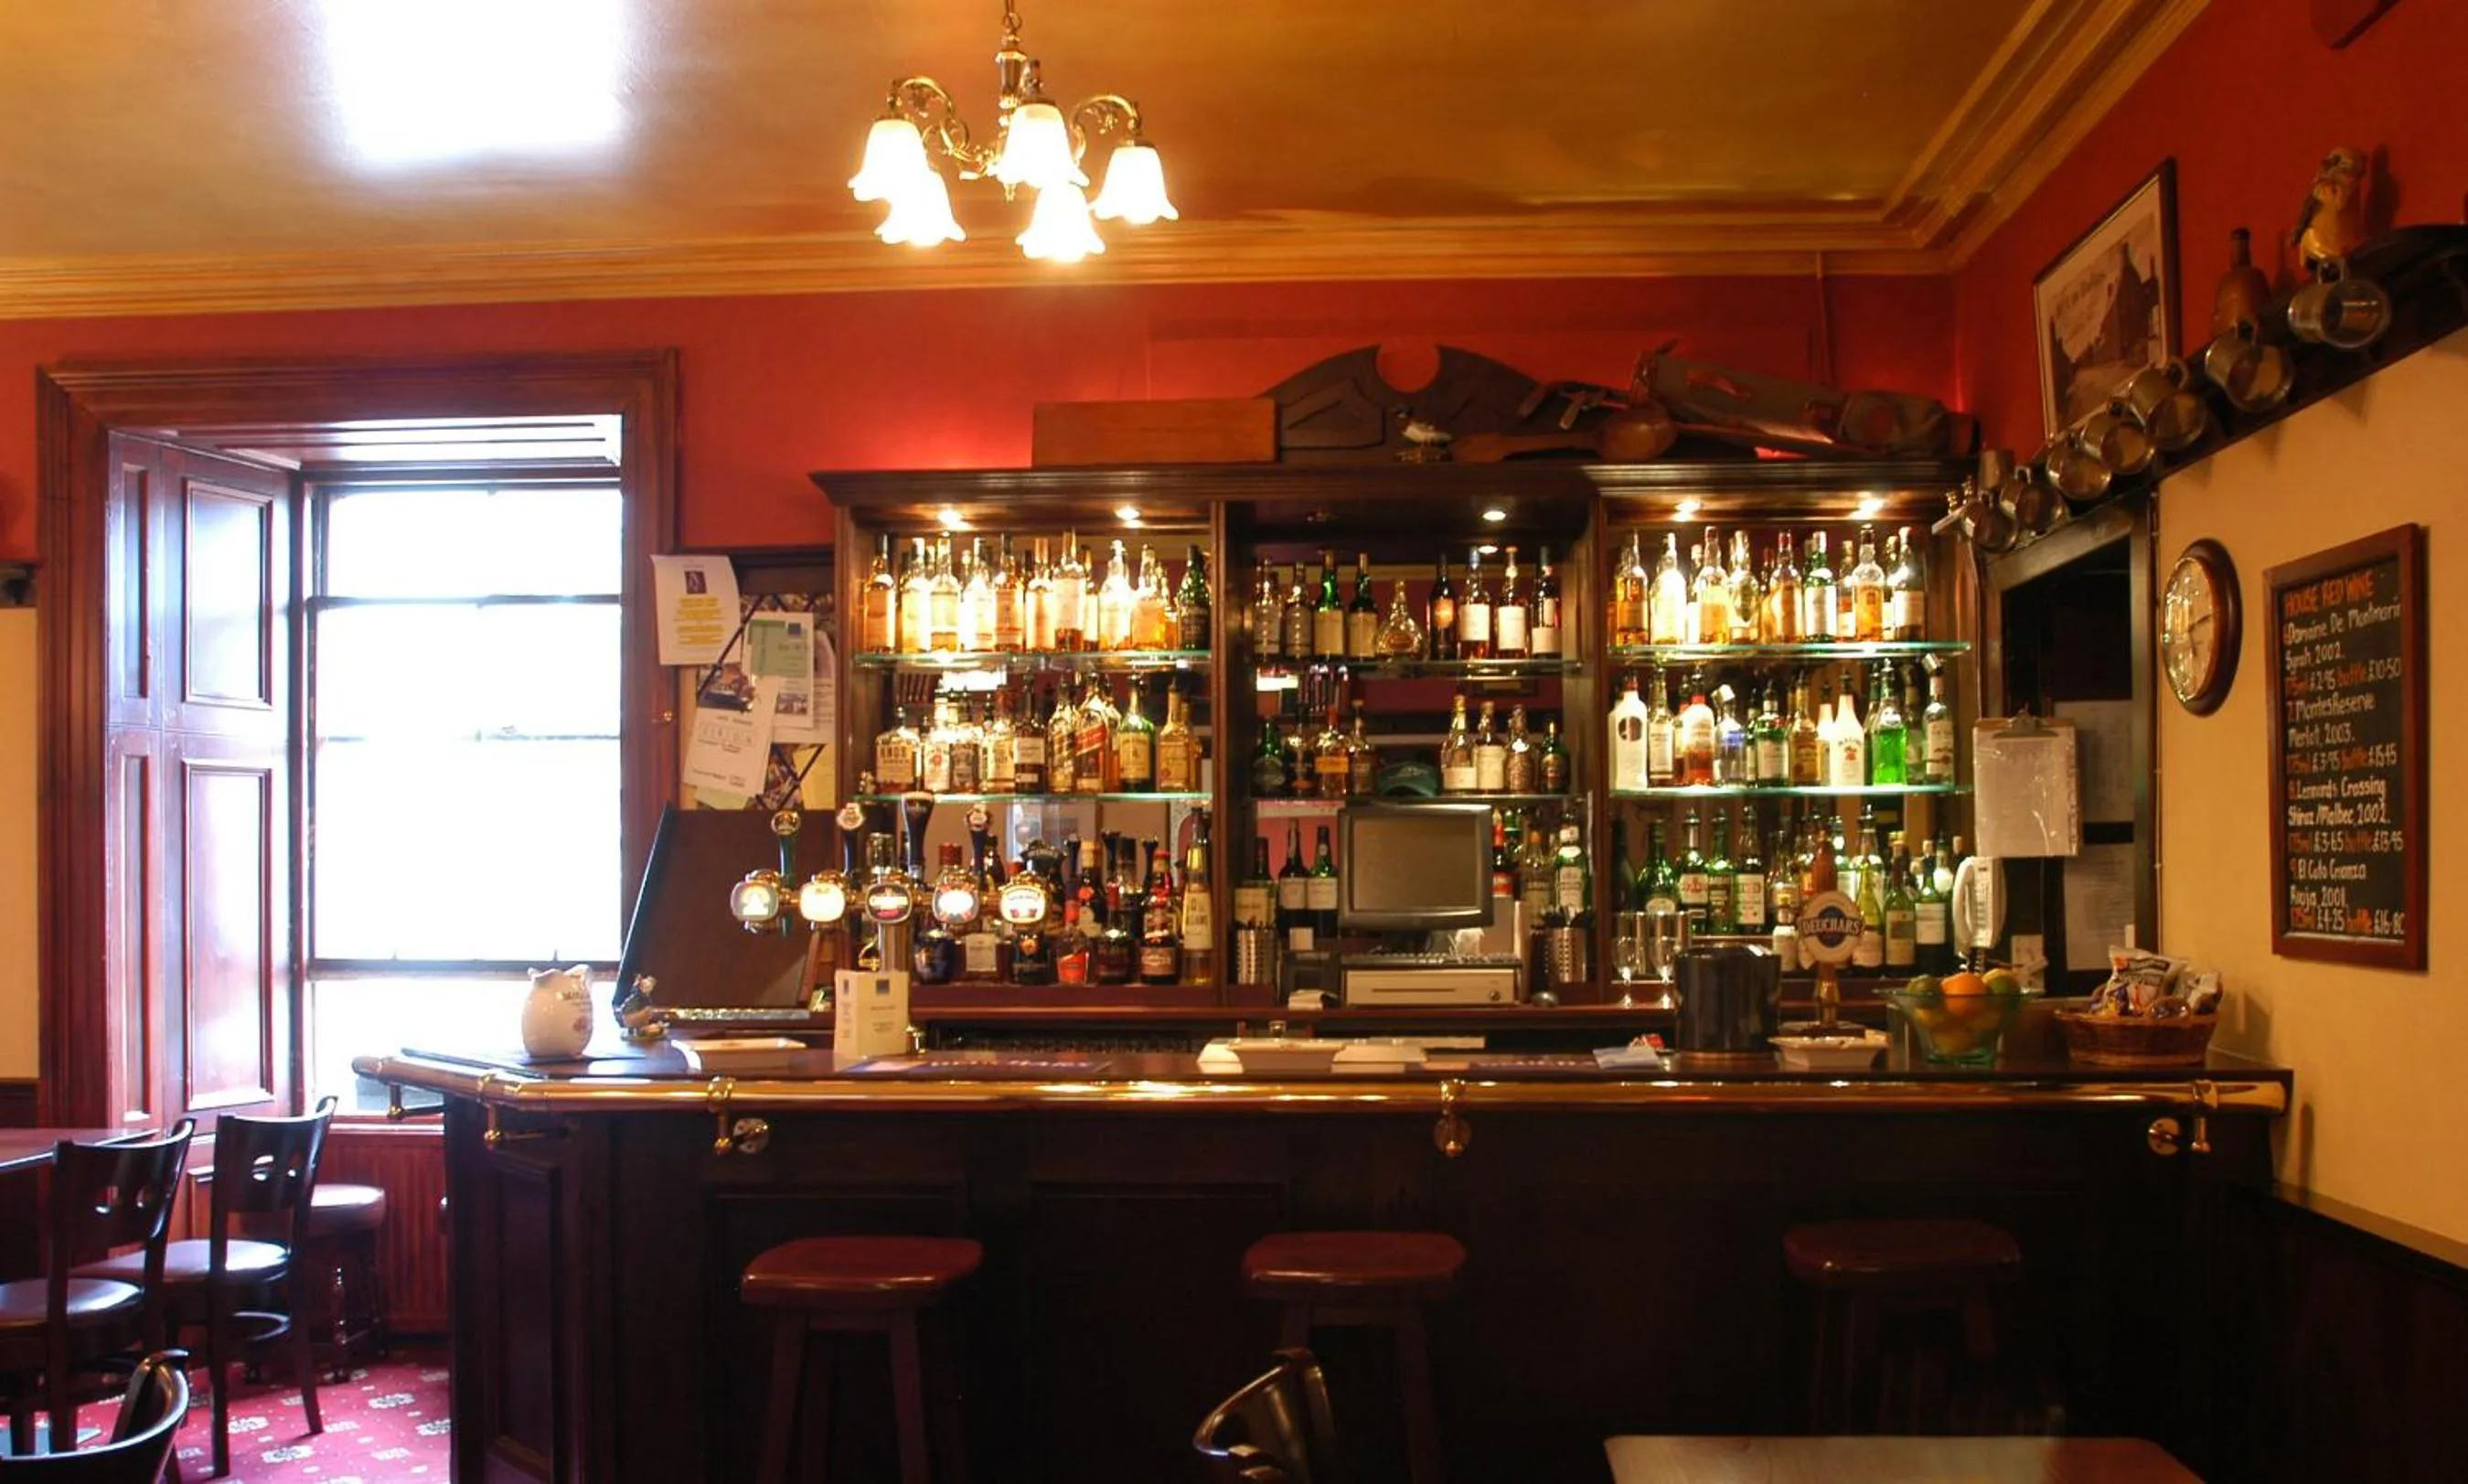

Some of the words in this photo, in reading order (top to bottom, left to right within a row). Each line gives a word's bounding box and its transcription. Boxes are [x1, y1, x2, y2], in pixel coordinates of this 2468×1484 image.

[2285, 586, 2318, 617] HOUSE
[2322, 579, 2344, 607] RED
[2345, 571, 2374, 603] WINE
[2330, 613, 2344, 633] De
[1802, 917, 1860, 934] DEUCHARS
